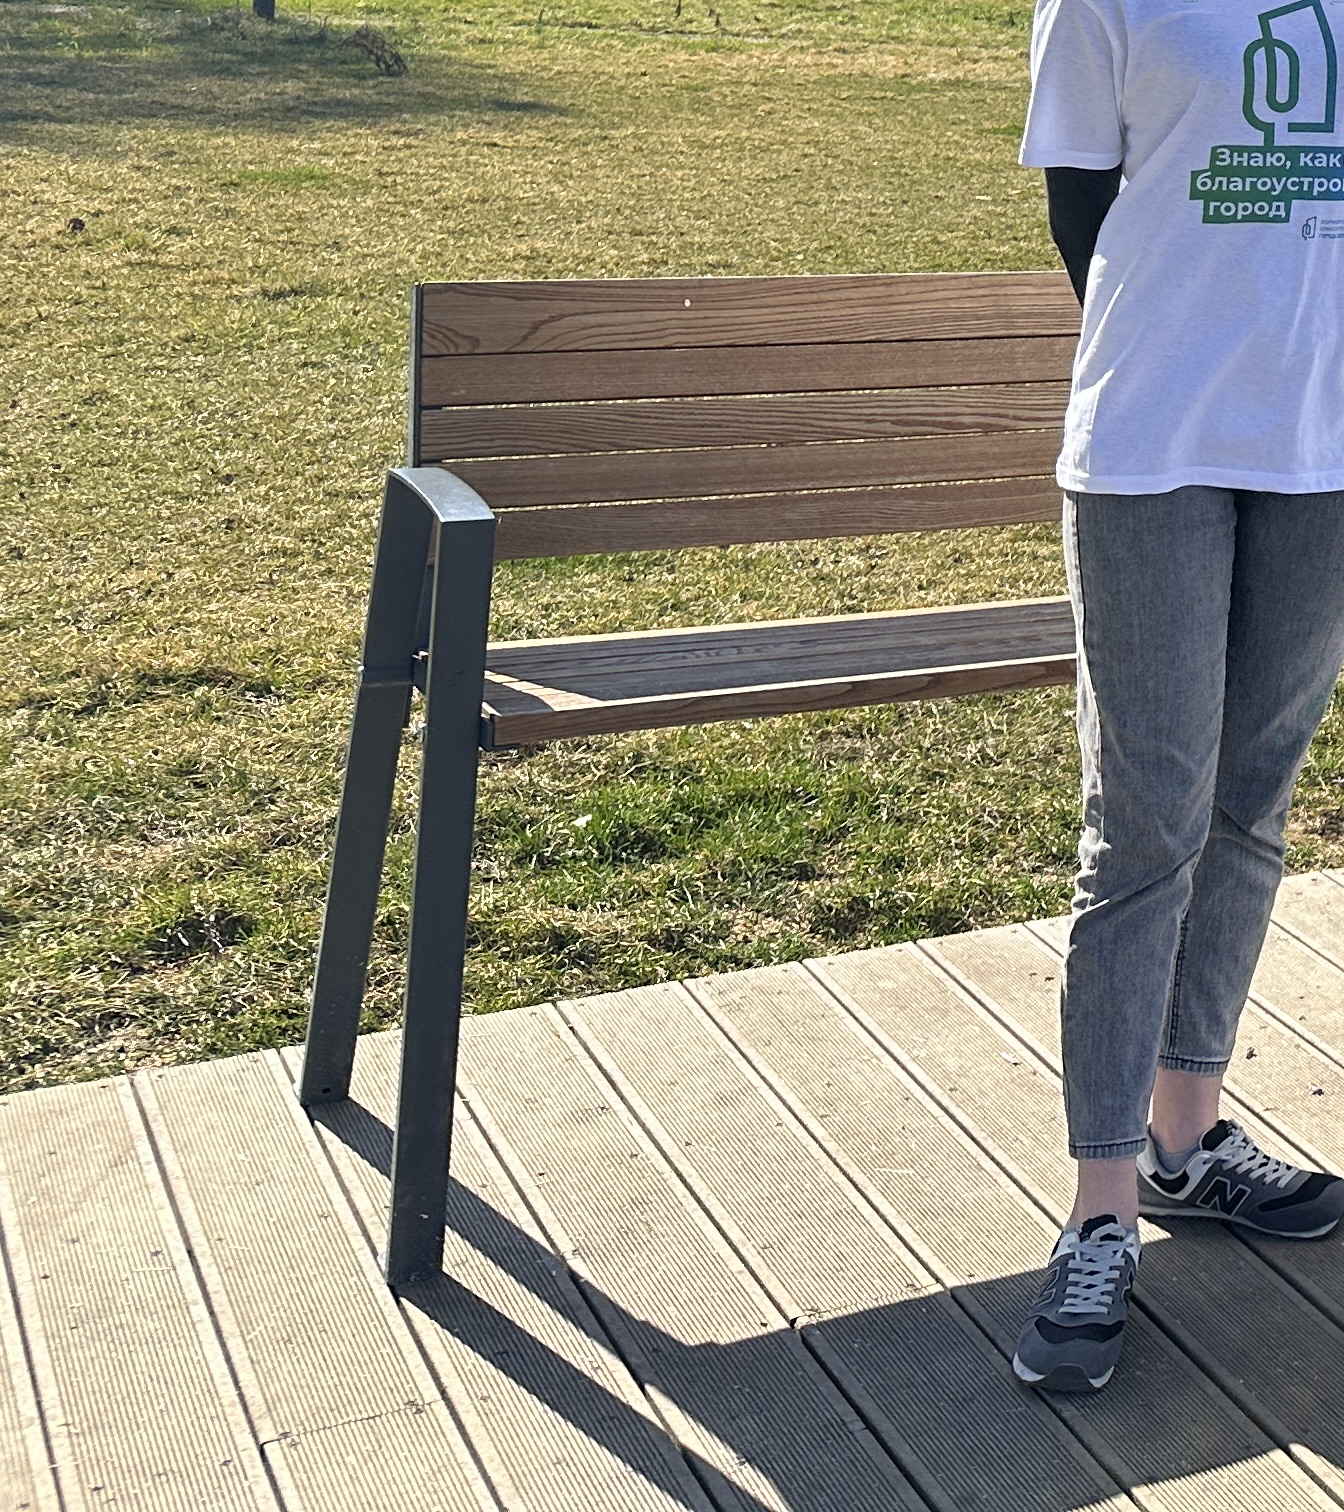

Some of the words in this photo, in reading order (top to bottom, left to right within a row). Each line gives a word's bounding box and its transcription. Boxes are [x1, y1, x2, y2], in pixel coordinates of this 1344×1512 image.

[1215, 148, 1291, 169] Знаю,
[1300, 152, 1342, 168] как
[1208, 201, 1286, 220] город
[1196, 1176, 1251, 1218] N
